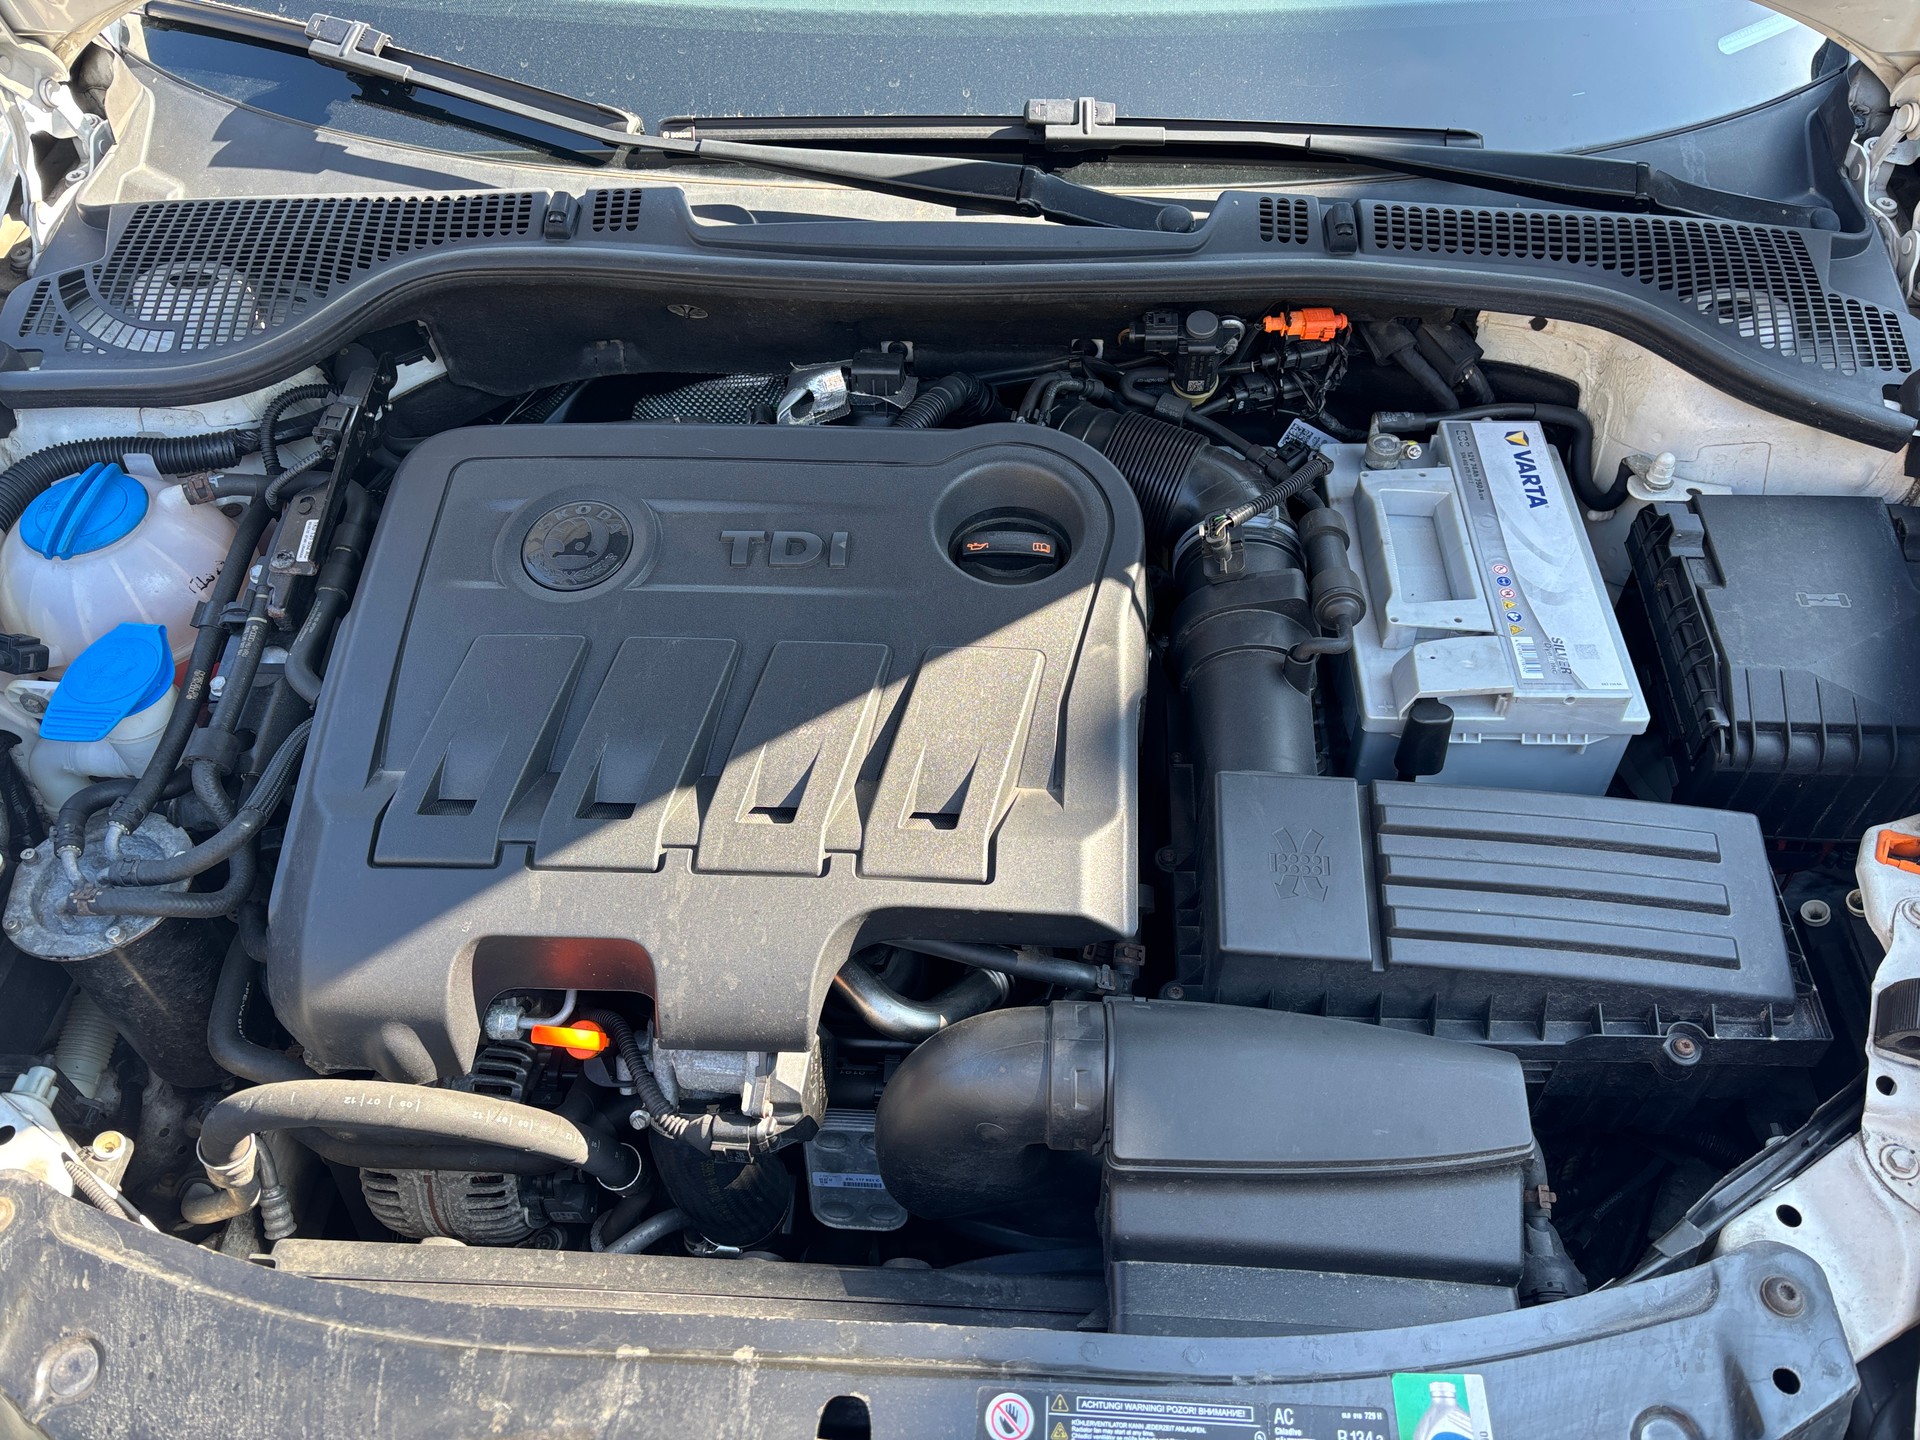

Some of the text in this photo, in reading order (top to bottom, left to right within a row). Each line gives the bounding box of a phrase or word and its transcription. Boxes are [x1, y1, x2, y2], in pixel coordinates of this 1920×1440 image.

[1513, 450, 1548, 508] VARTA
[719, 530, 850, 569] TDI
[1551, 637, 1572, 675] SILVER
[1081, 1400, 1197, 1414] ACHTUNG! WARNING! POZOR!
[1198, 1407, 1246, 1417] ВНИМАНИЕ!
[1274, 1407, 1294, 1425] AC
[1072, 1419, 1127, 1428] KÜHLERVENTILATOR
[1145, 1423, 1175, 1432] JEDERZEIT
